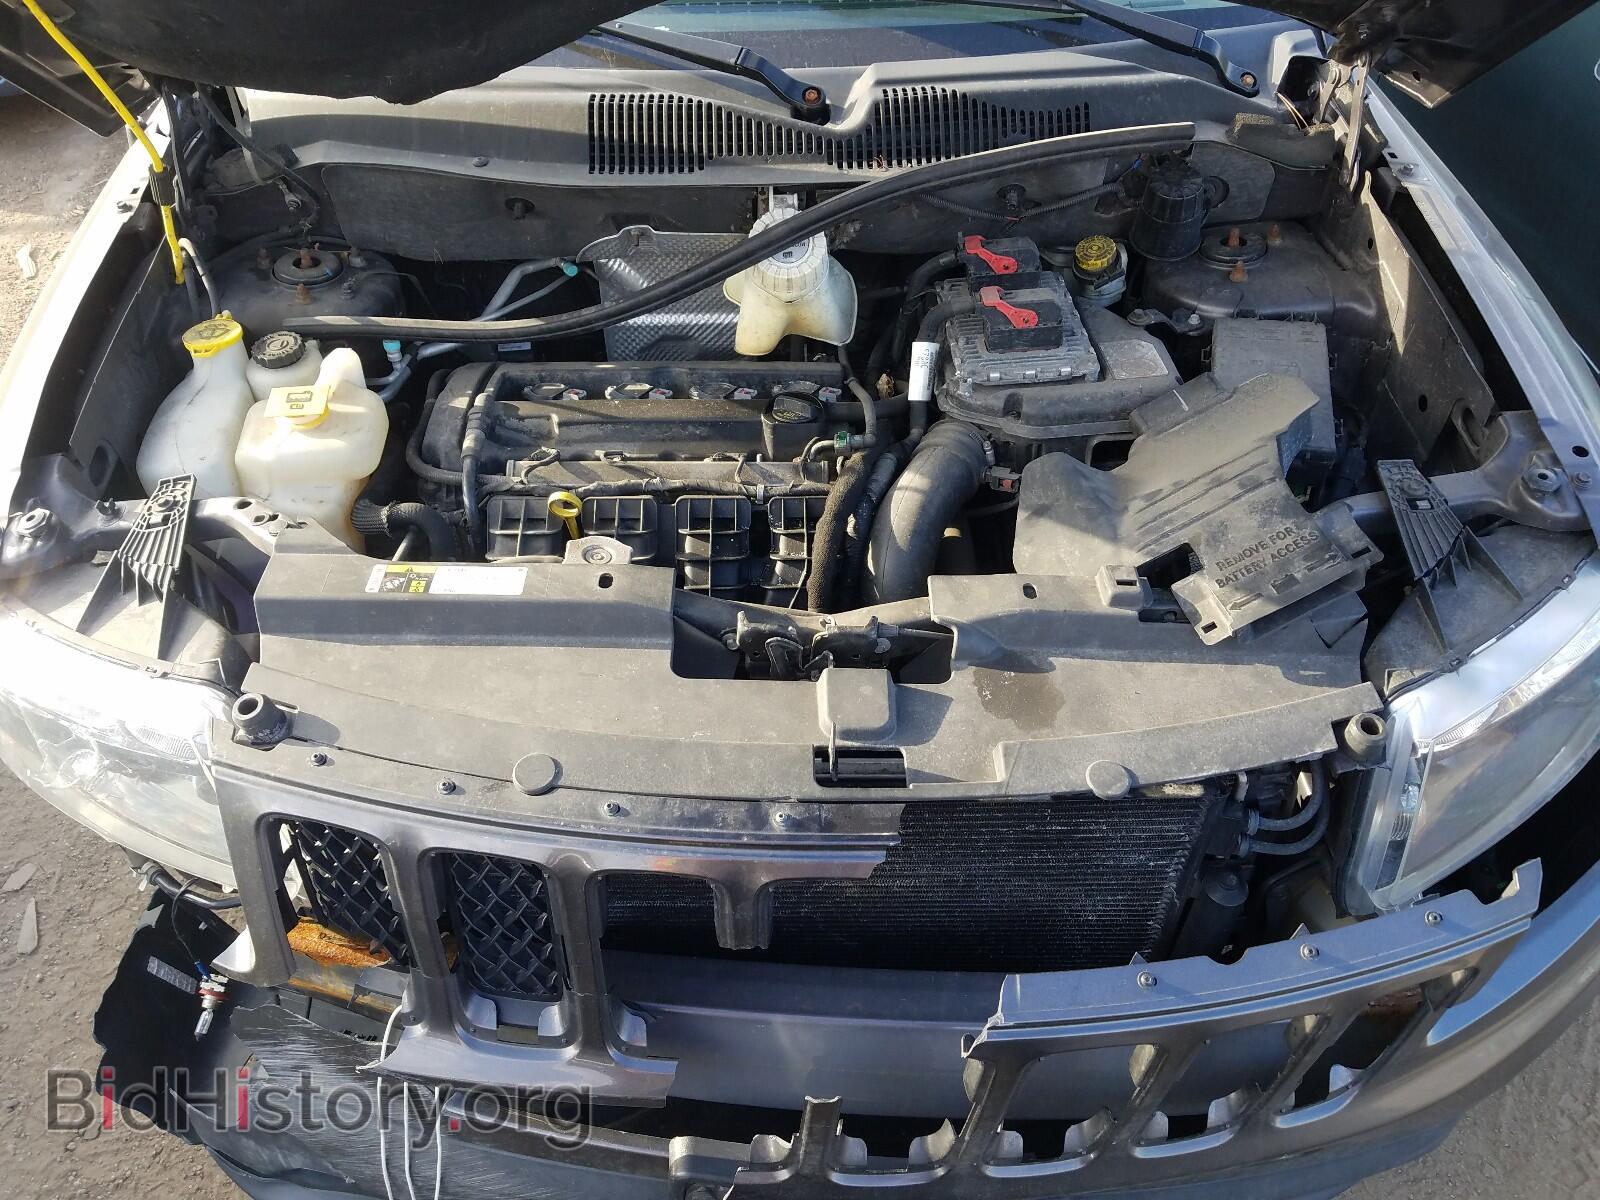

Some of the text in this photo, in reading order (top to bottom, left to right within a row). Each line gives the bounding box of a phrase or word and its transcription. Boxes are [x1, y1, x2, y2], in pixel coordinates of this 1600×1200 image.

[1214, 531, 1320, 589] BATTERY ACCESS
[1215, 525, 1297, 572] REMOVE FOR
